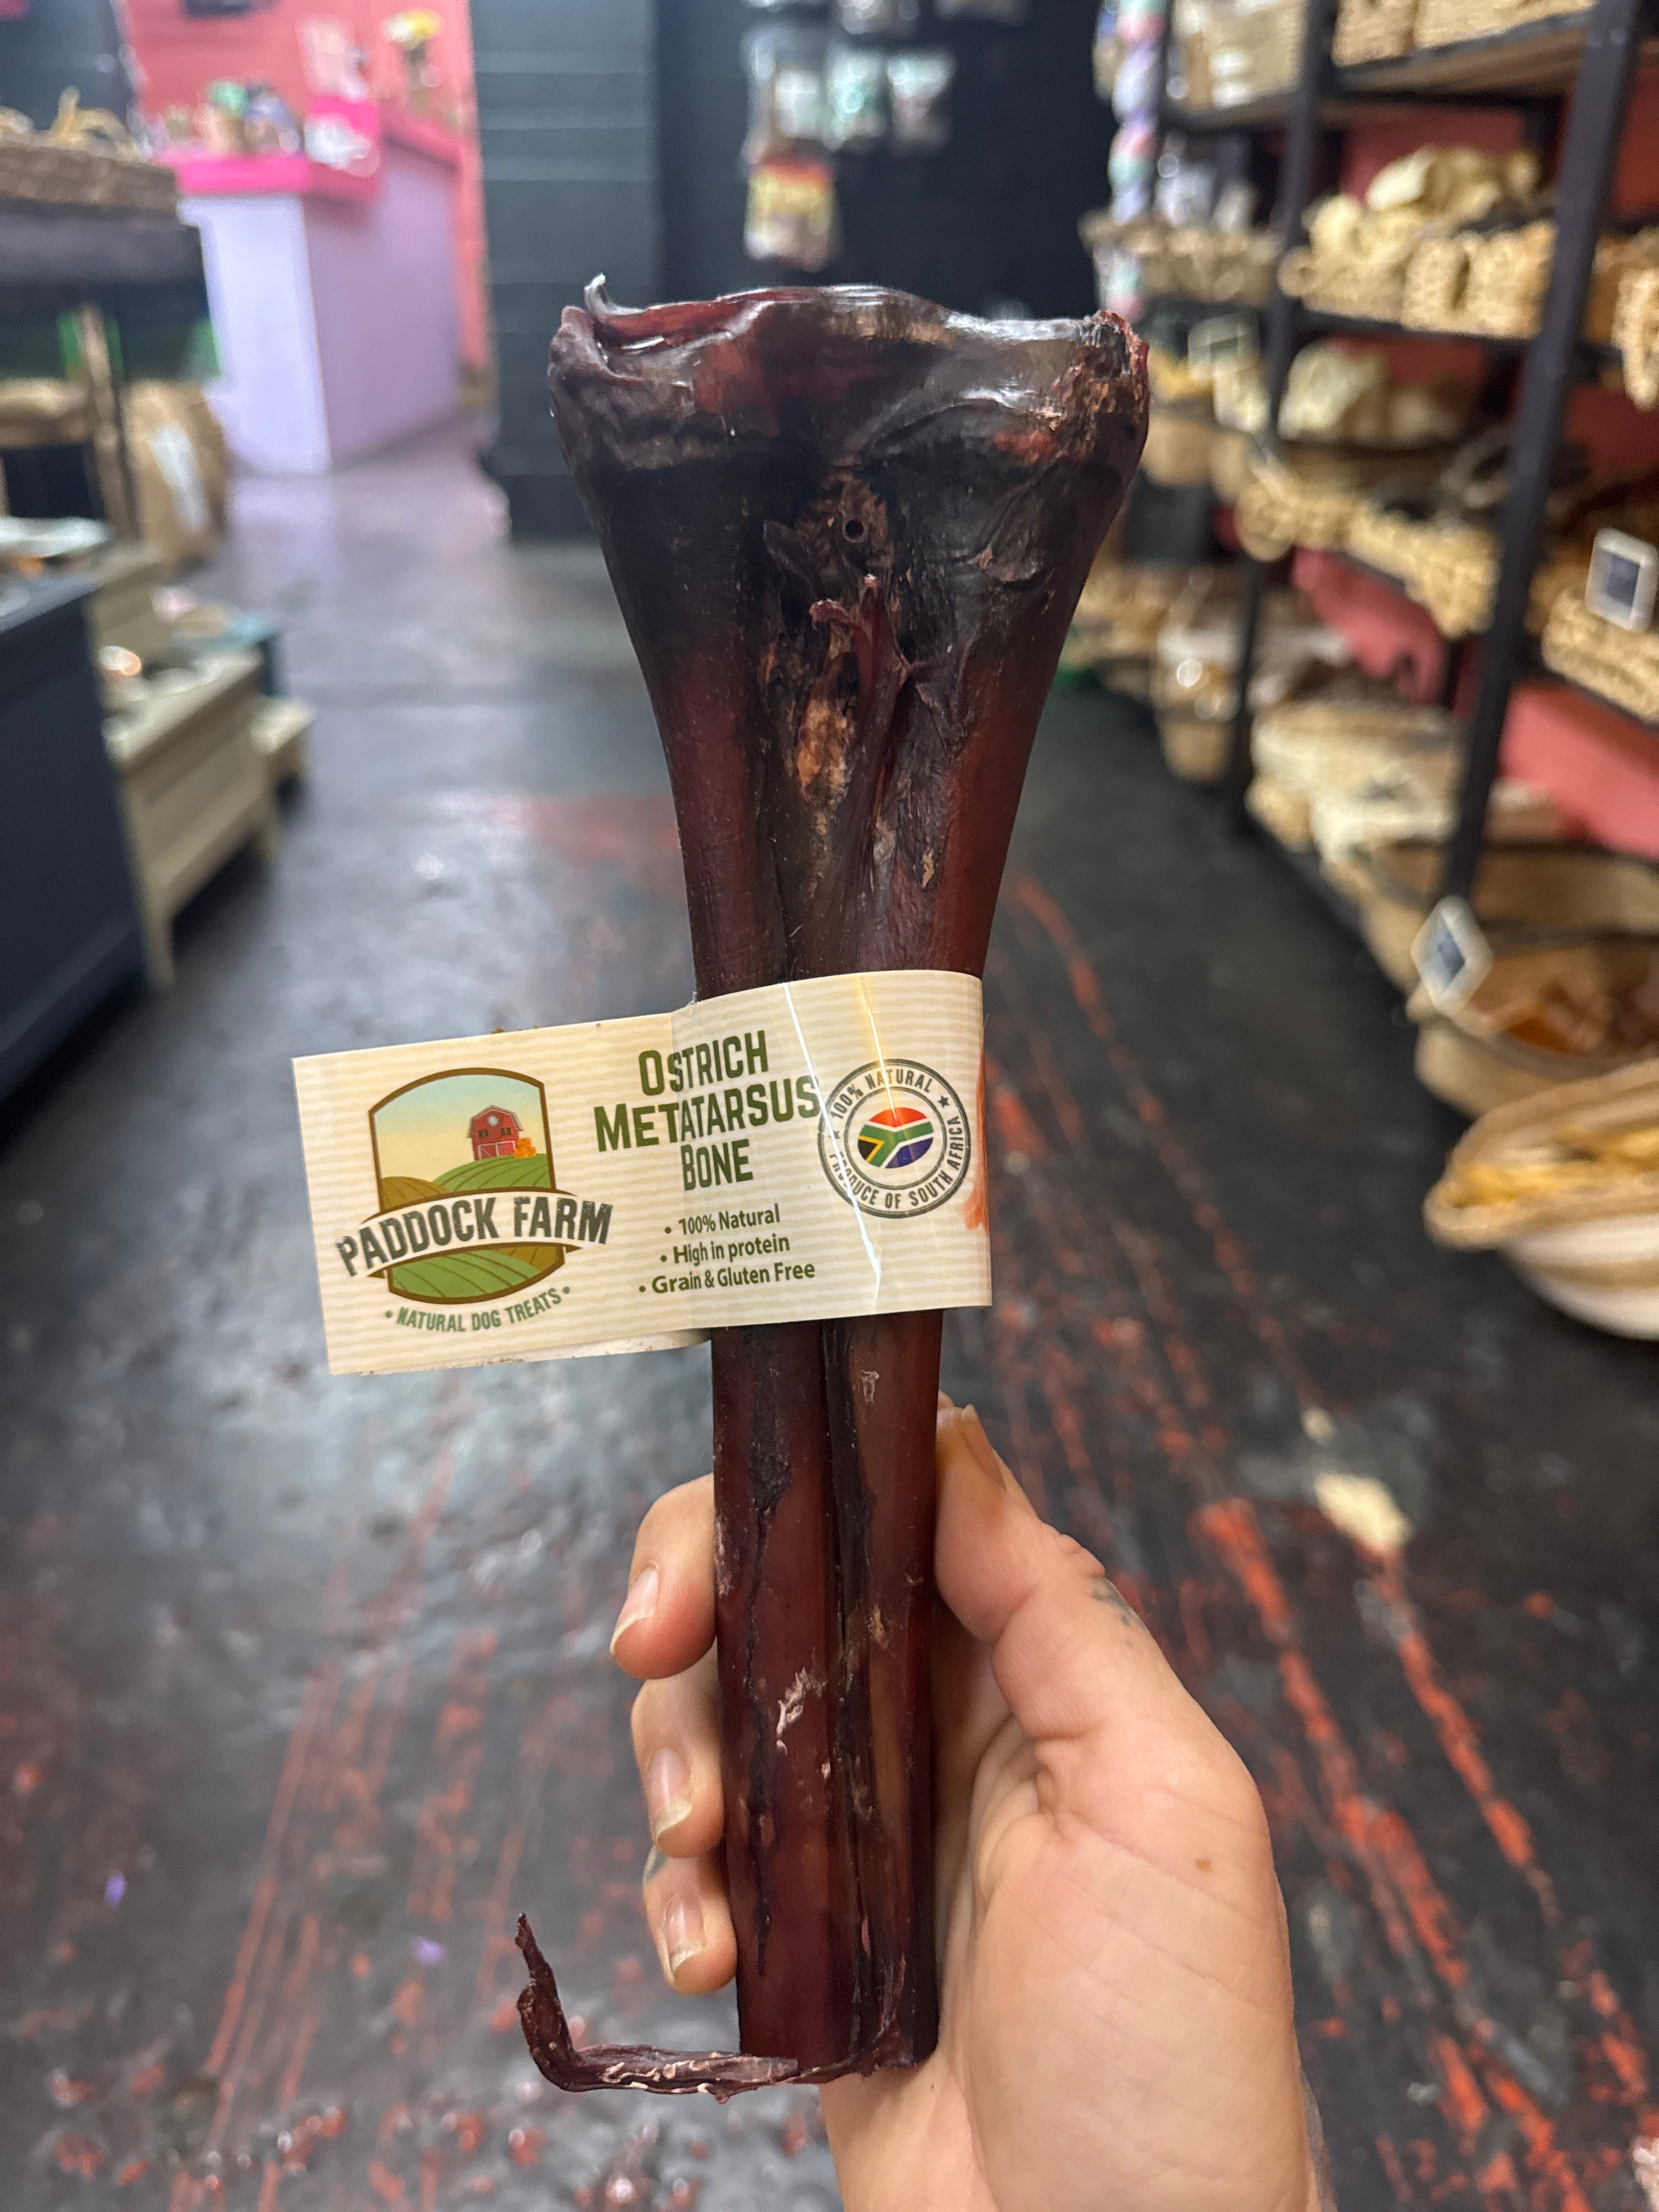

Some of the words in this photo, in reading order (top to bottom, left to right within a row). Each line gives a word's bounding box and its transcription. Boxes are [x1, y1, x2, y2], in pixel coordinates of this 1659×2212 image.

[638, 1030, 769, 1096] OSTRICH
[594, 1075, 821, 1152] METATARSUS
[830, 1084, 864, 1119] 100%
[864, 1069, 934, 1093] NATURAL
[681, 1138, 754, 1191] BONE
[884, 1192, 901, 1209] OF
[909, 1170, 953, 1206] SOUTH
[946, 1115, 964, 1171] AFRICA
[334, 1197, 500, 1277] PADDOCK
[513, 1196, 613, 1245] FARM
[678, 1214, 716, 1235] 100%
[718, 1203, 780, 1231] Natural
[673, 1241, 708, 1267] High
[710, 1240, 725, 1260] in
[728, 1233, 790, 1262] protein
[652, 1271, 702, 1294] Grain
[704, 1269, 715, 1288] &
[717, 1266, 771, 1286] Gluten
[774, 1262, 816, 1282] Free
[396, 1306, 466, 1332] NATURAL
[471, 1309, 502, 1331] DOG
[504, 1287, 562, 1324] TREATS
